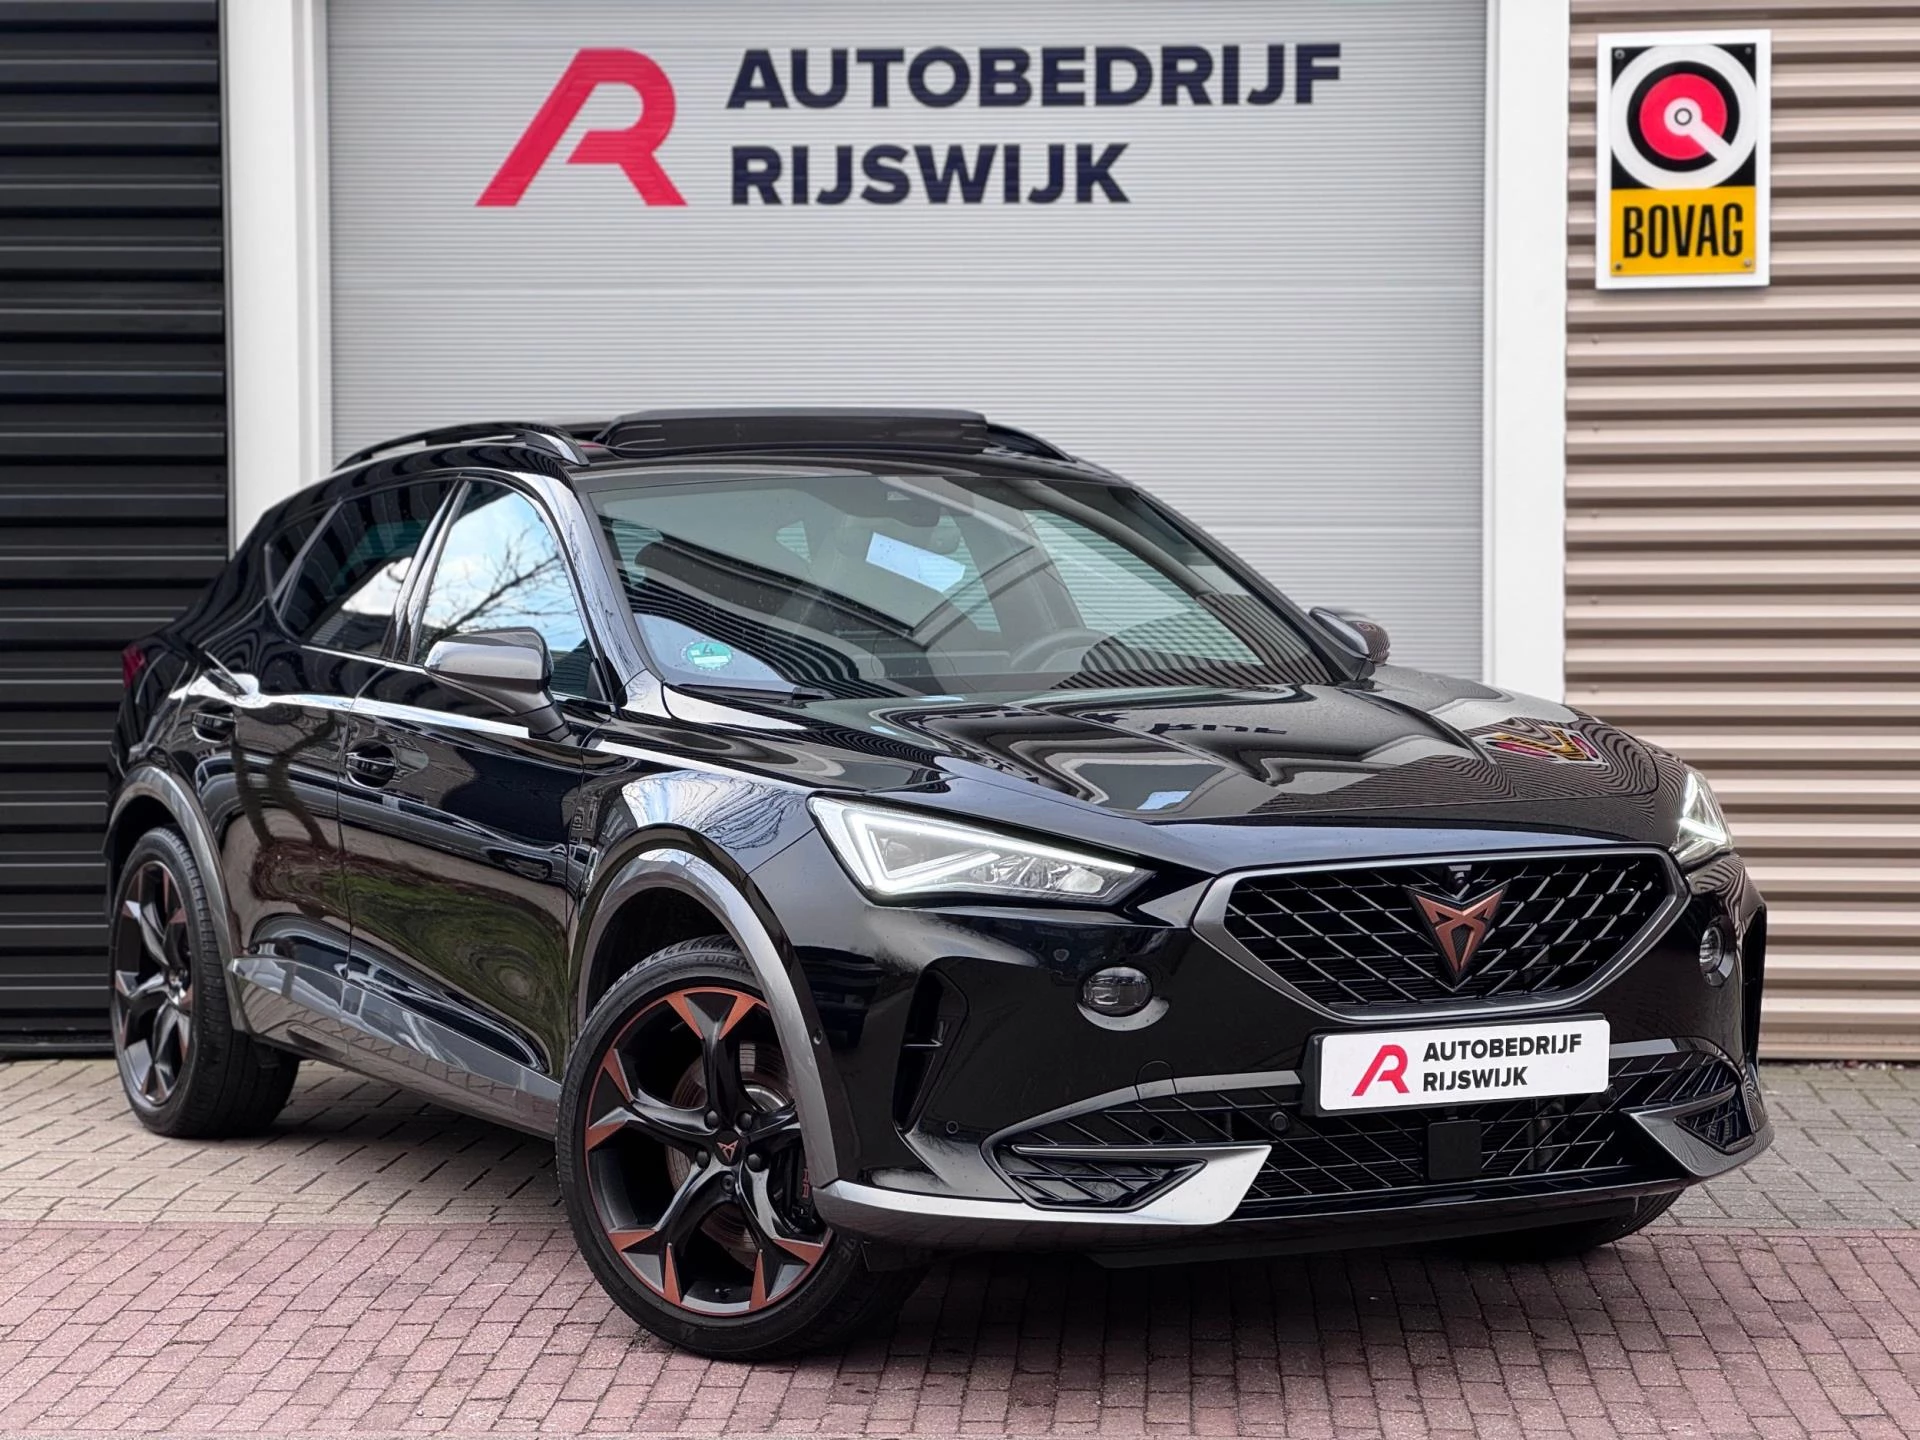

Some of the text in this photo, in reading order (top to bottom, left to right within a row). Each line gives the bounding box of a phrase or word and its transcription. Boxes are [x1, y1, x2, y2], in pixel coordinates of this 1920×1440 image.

[726, 43, 1341, 109] AUTOBEDRIJF
[731, 143, 1129, 206] RIJSWIJK
[1622, 202, 1744, 260] BOVAG
[1422, 1033, 1582, 1062] AUTOBEDRIJF
[1423, 1066, 1528, 1092] RIJSWIJK
